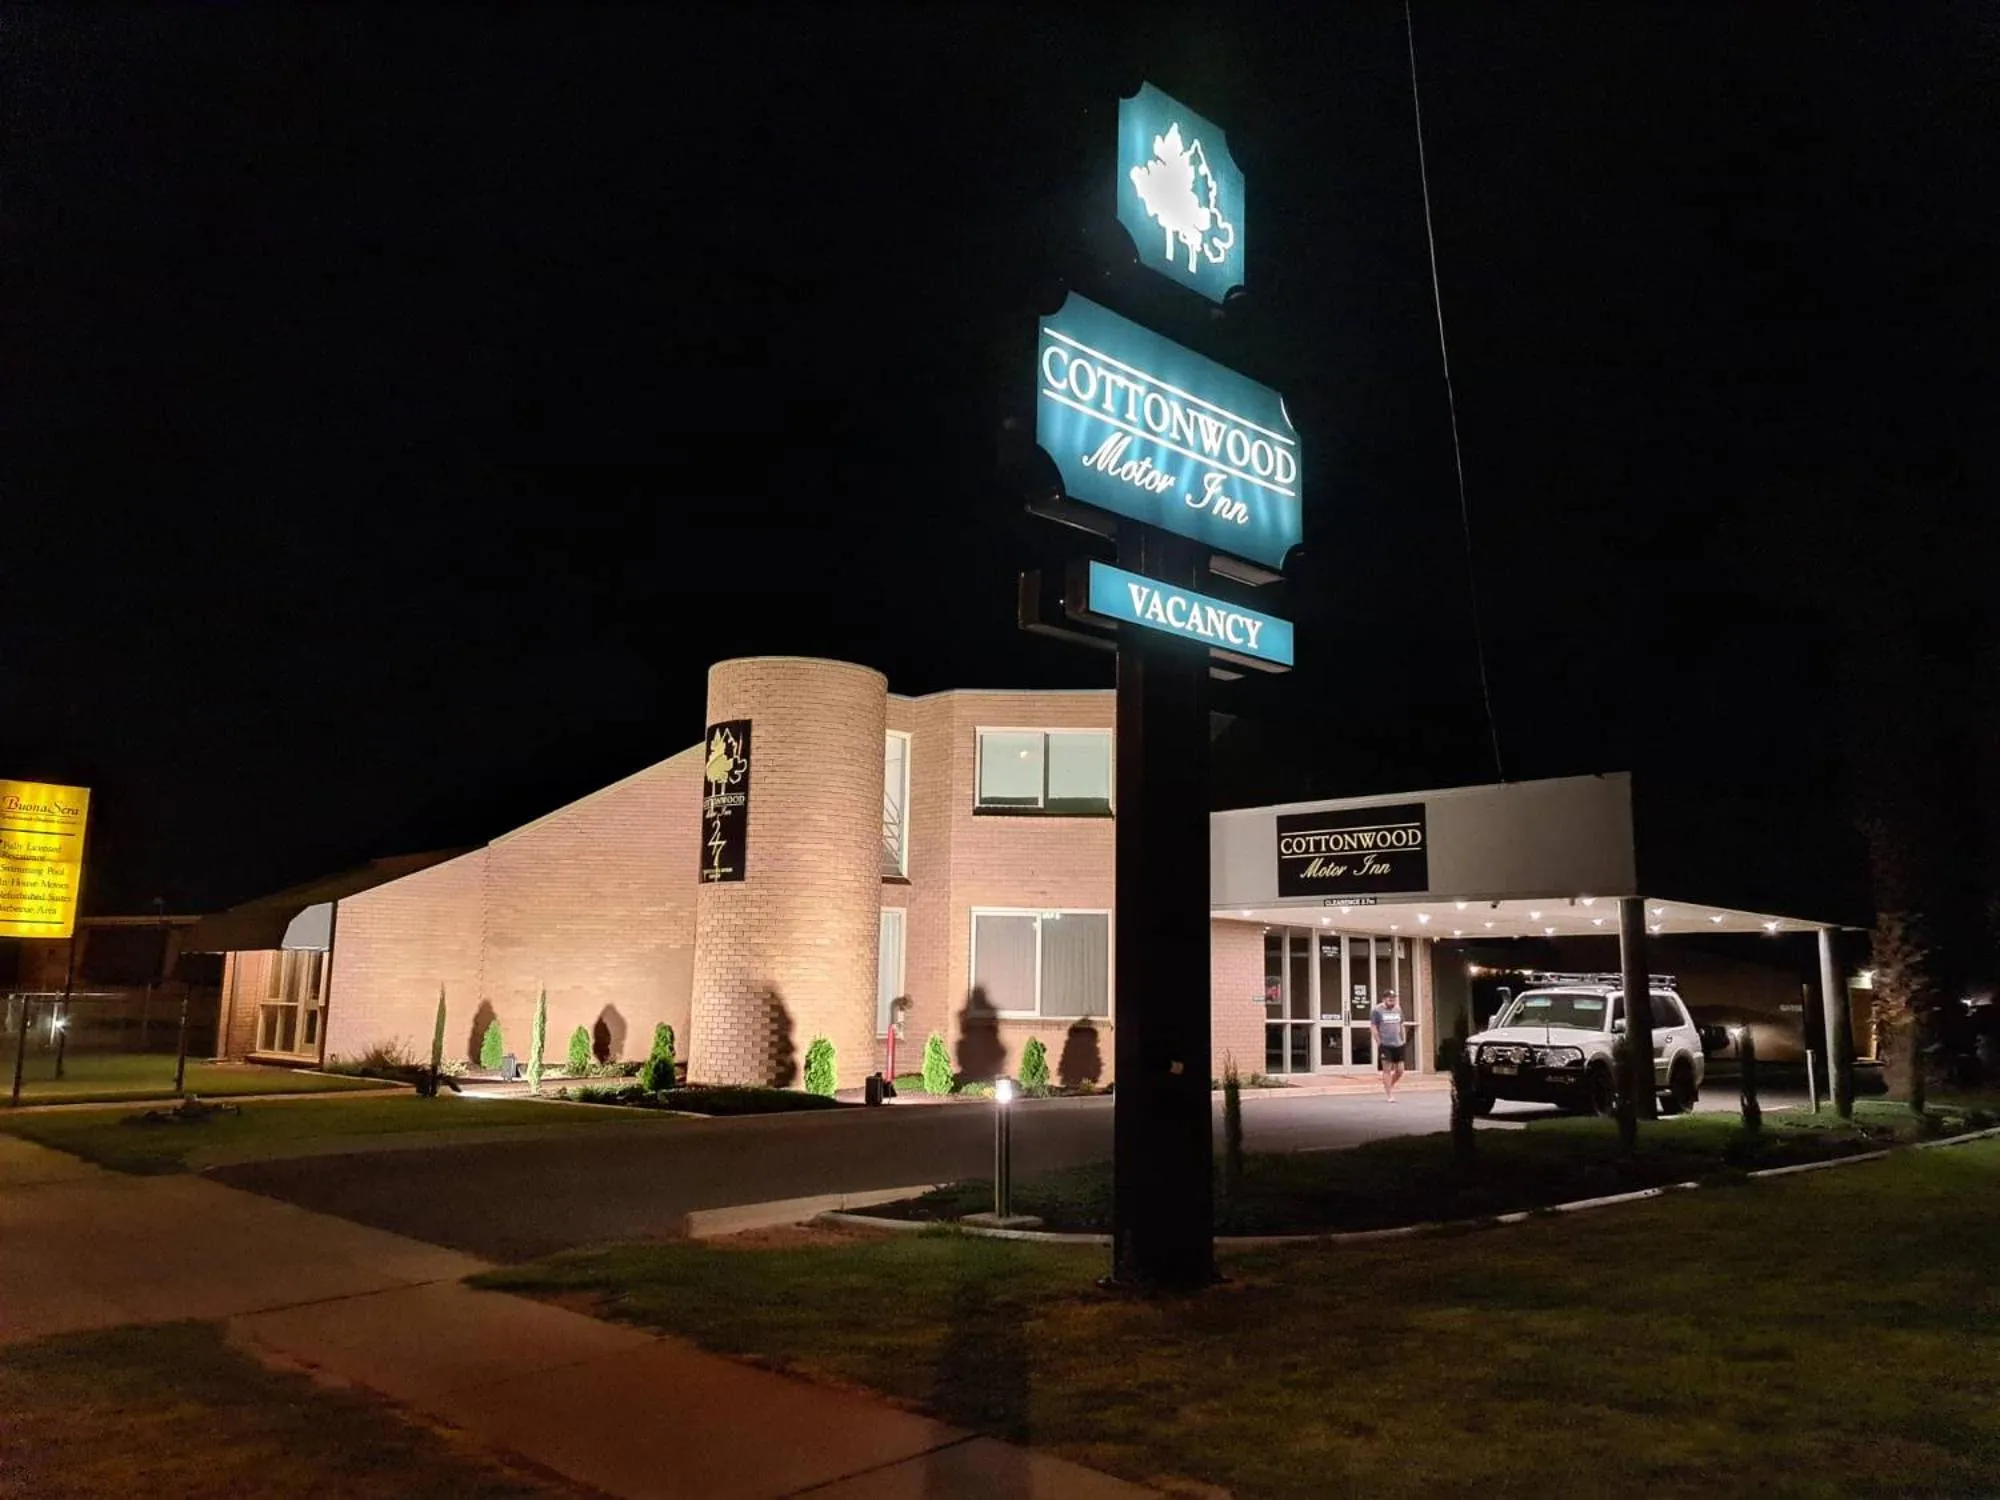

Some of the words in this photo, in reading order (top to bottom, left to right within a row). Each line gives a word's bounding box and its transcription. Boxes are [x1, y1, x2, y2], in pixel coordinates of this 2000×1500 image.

[1042, 346, 1296, 484] COTTONWOOD
[1082, 431, 1176, 494] Motor
[1185, 472, 1249, 524] Inn
[1127, 582, 1264, 649] VACANCY
[3, 795, 50, 813] Buona
[1280, 829, 1422, 855] COTTONWOOD
[47, 866, 65, 876] Pool
[1300, 857, 1348, 879] Motor
[1353, 853, 1391, 876] Inn
[0, 904, 35, 914] arbecue
[37, 906, 57, 915] Area
